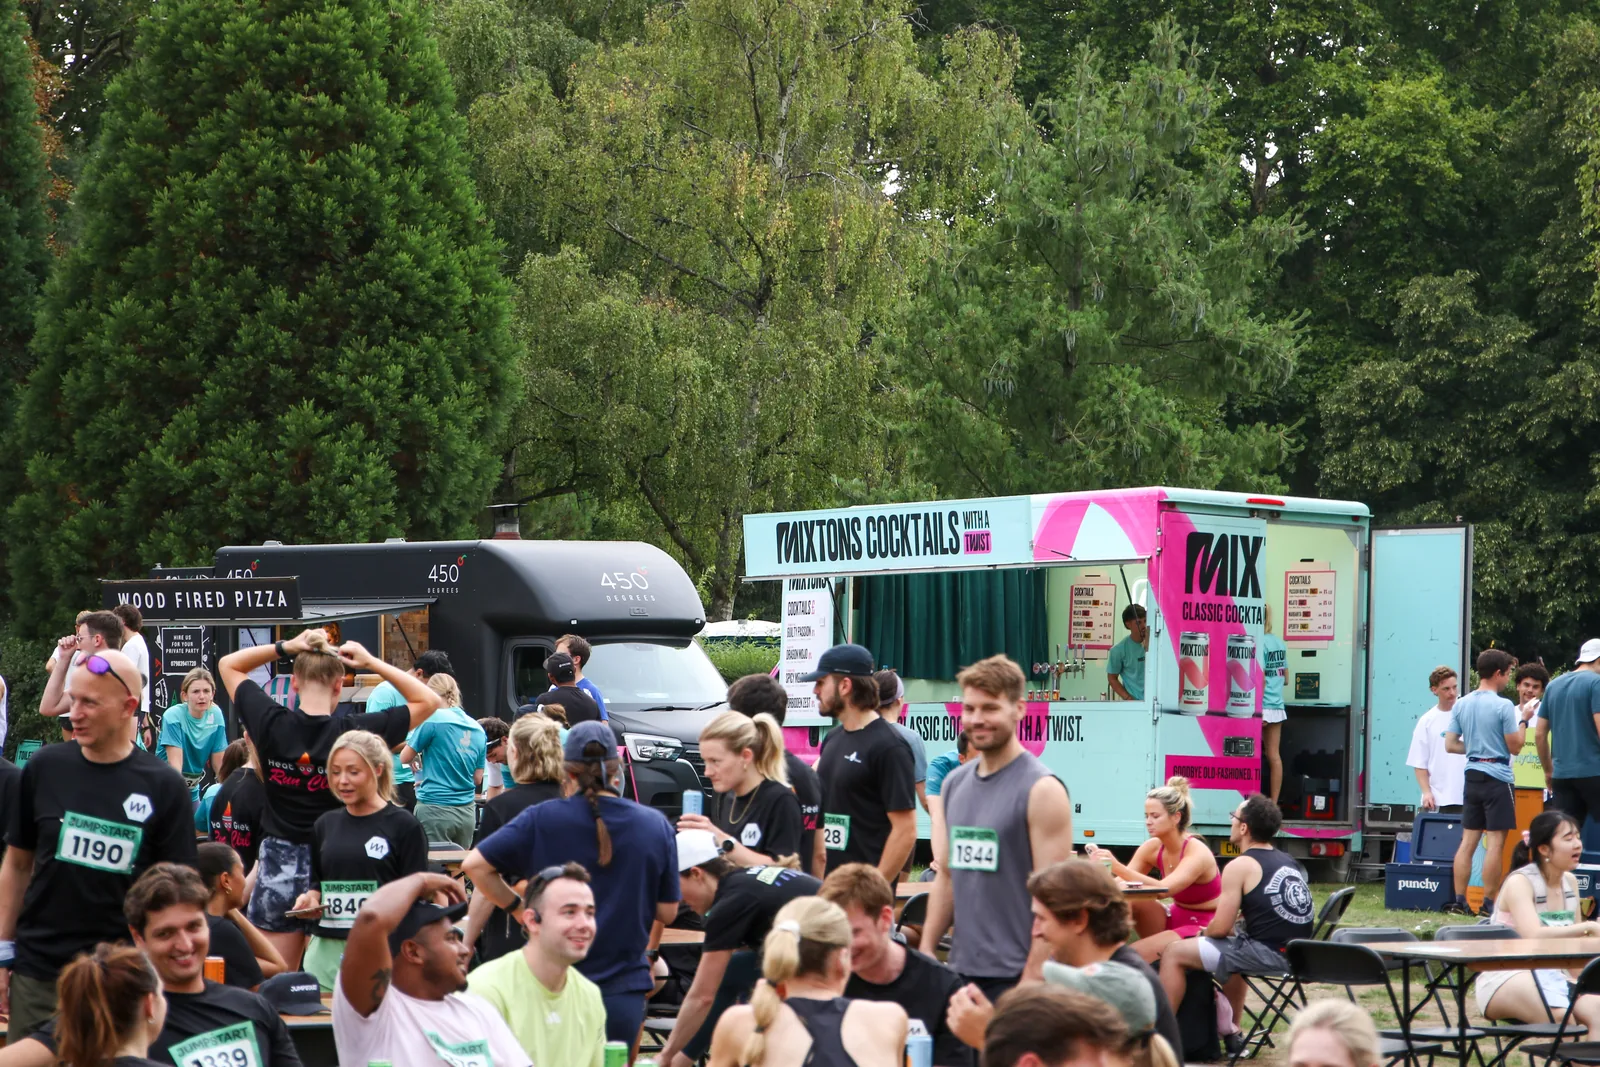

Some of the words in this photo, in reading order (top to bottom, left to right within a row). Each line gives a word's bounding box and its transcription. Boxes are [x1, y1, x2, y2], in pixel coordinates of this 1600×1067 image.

[962, 510, 983, 529] WITH
[984, 510, 990, 529] A
[776, 515, 863, 565] MIXTONS
[866, 510, 961, 560] COCKTAILS
[964, 532, 990, 553] TWIST
[428, 564, 459, 583] 450
[1184, 531, 1266, 599] MIX
[601, 572, 649, 590] 450
[1289, 575, 1311, 585] COCKTAILS
[118, 592, 166, 609] WOOD
[175, 591, 225, 609] FIRED
[235, 590, 288, 608] PIZZA
[606, 594, 656, 602] DEGREES
[1074, 587, 1094, 597] COCKTAILS
[787, 600, 811, 616] COCKTAILS
[1182, 601, 1223, 624] CLASSIC
[1180, 643, 1209, 656] MIXTONS
[1228, 646, 1256, 659] MIXTONS
[1034, 716, 1042, 741] A
[1045, 715, 1084, 742] TWIST.
[267, 759, 294, 771] Heat
[1173, 765, 1203, 779] GOODBYE
[1204, 766, 1253, 780] OLD-FASHIONED.
[269, 768, 301, 786] Run
[68, 816, 137, 840] JUMPSTART
[71, 835, 124, 864] 1190
[956, 845, 993, 864] 1844
[324, 883, 374, 893] JUMPSTART
[1398, 878, 1440, 893] punchy
[176, 1027, 248, 1057] JUMPSTART
